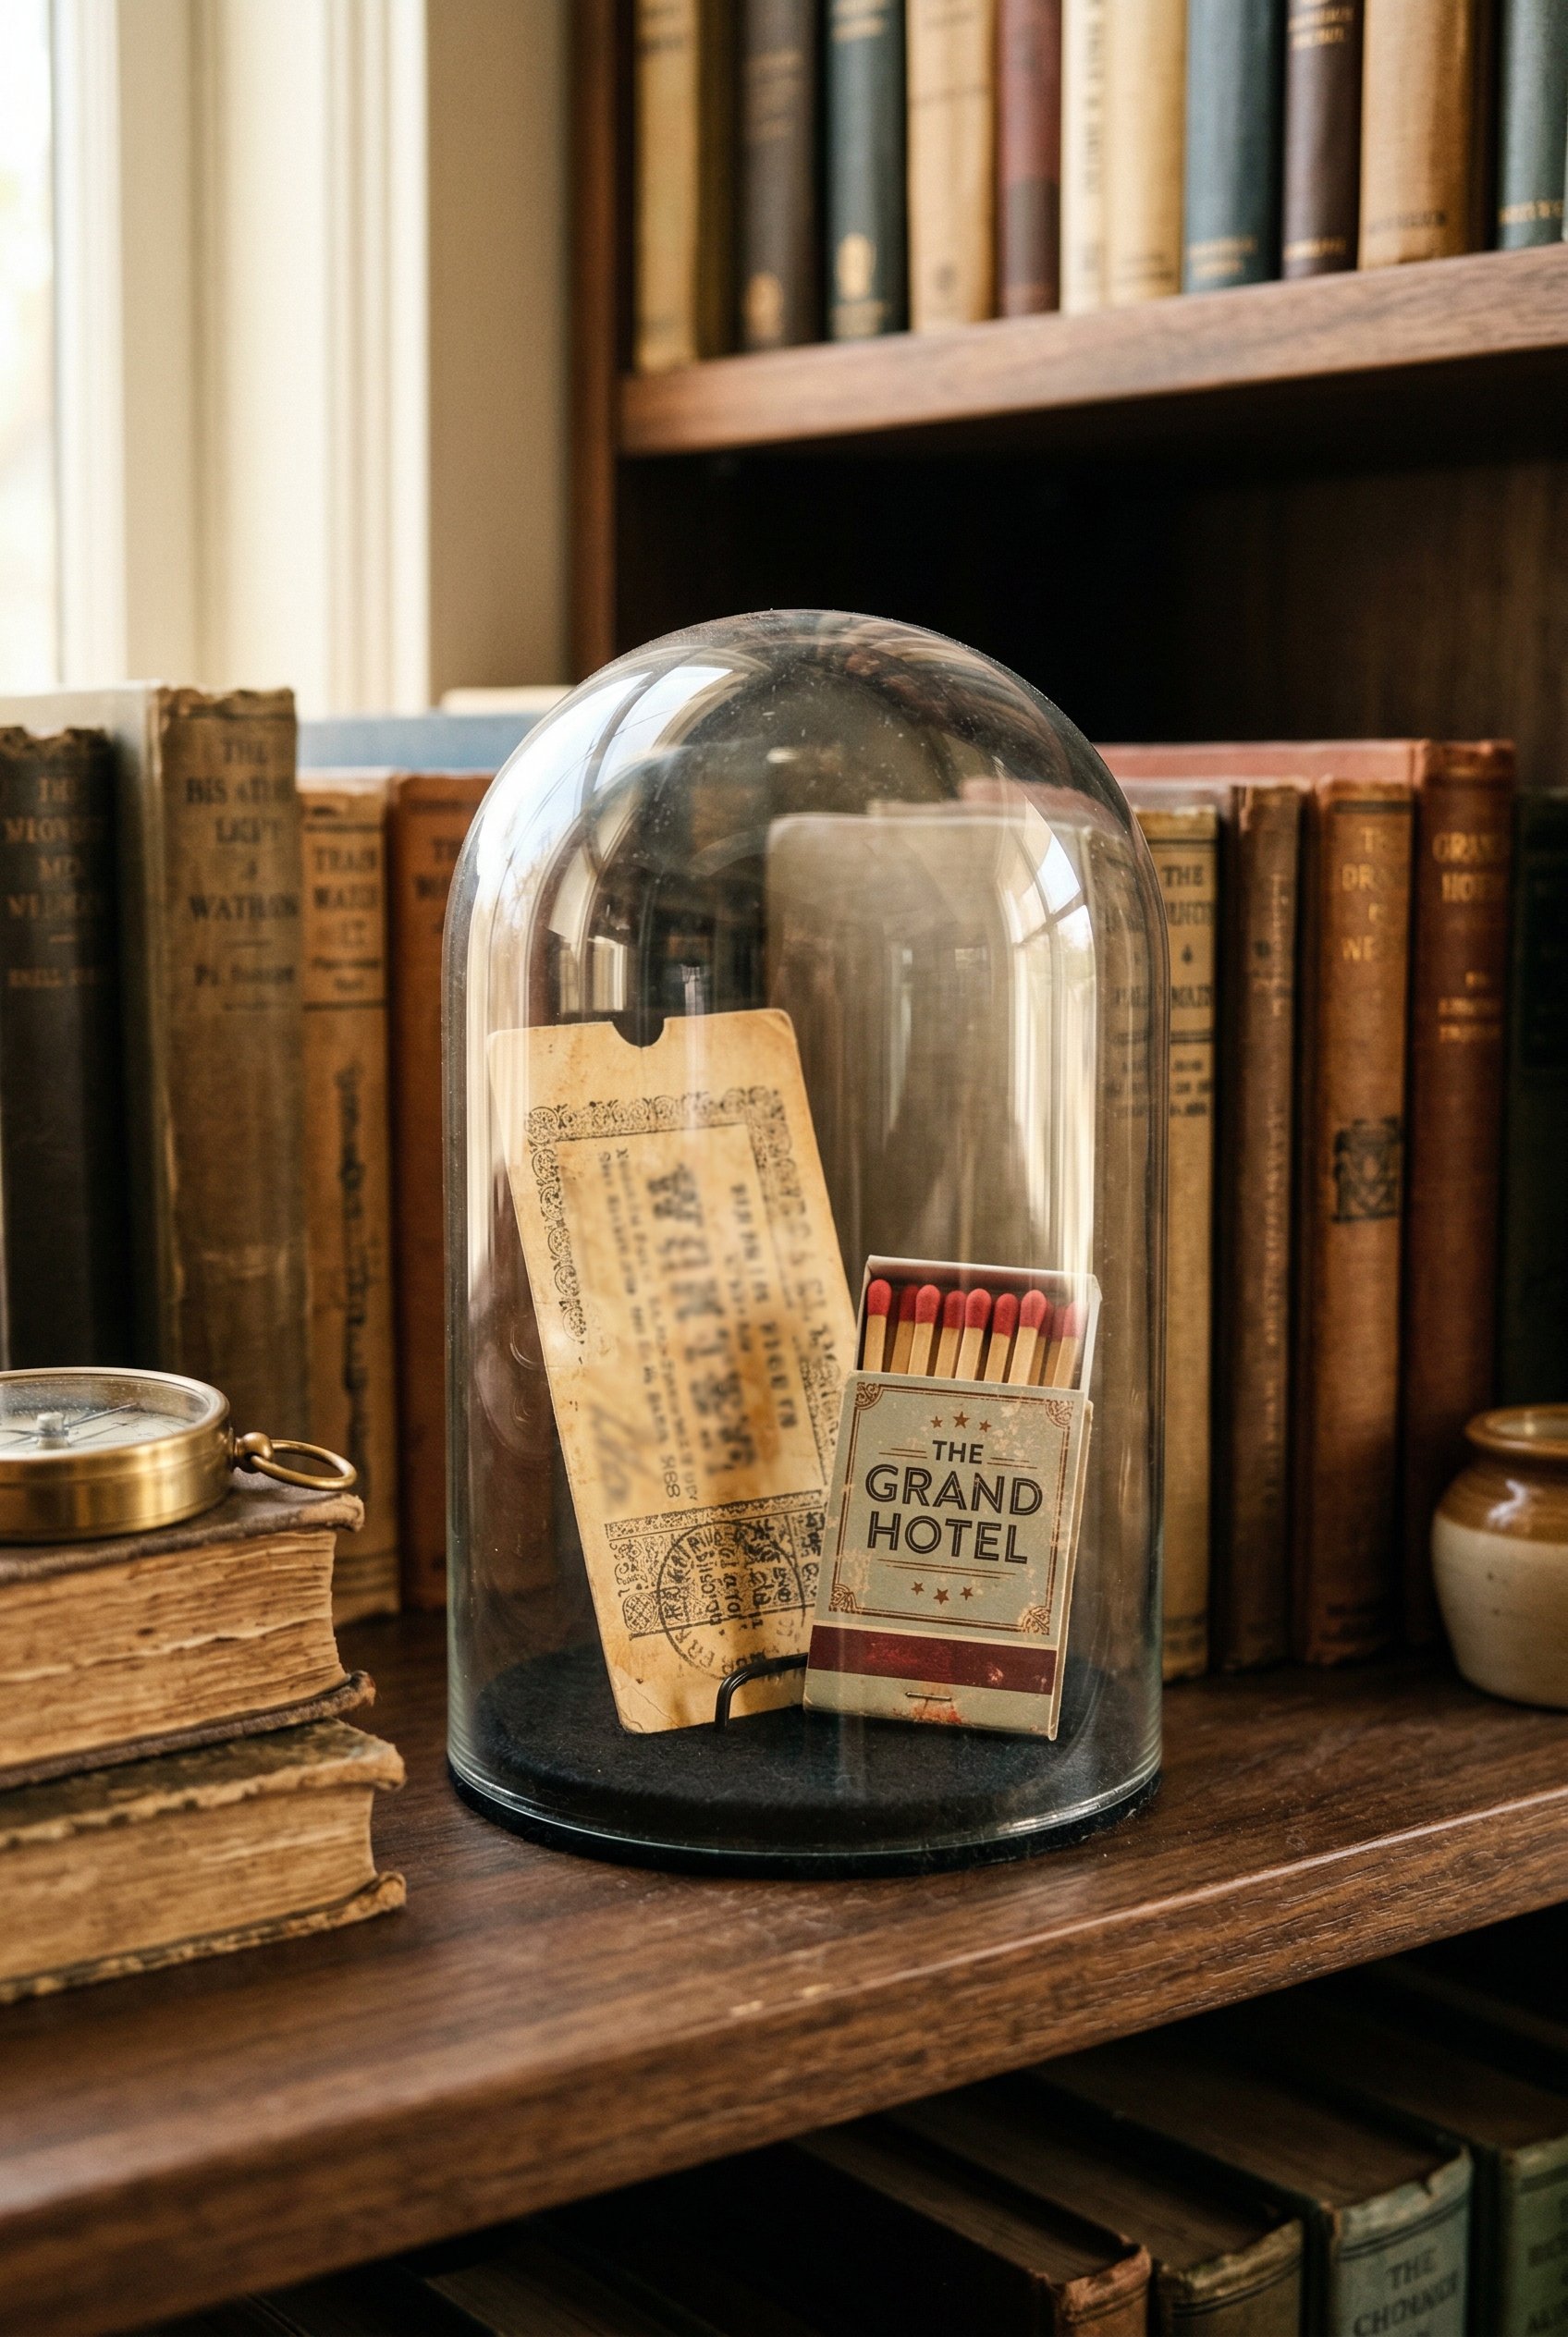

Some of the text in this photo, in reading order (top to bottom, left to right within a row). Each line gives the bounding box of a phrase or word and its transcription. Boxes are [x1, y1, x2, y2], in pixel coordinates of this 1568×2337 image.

[932, 1439, 984, 1464] THE
[864, 1463, 1043, 1516] GRAND
[867, 1511, 1028, 1565] HOTEL
